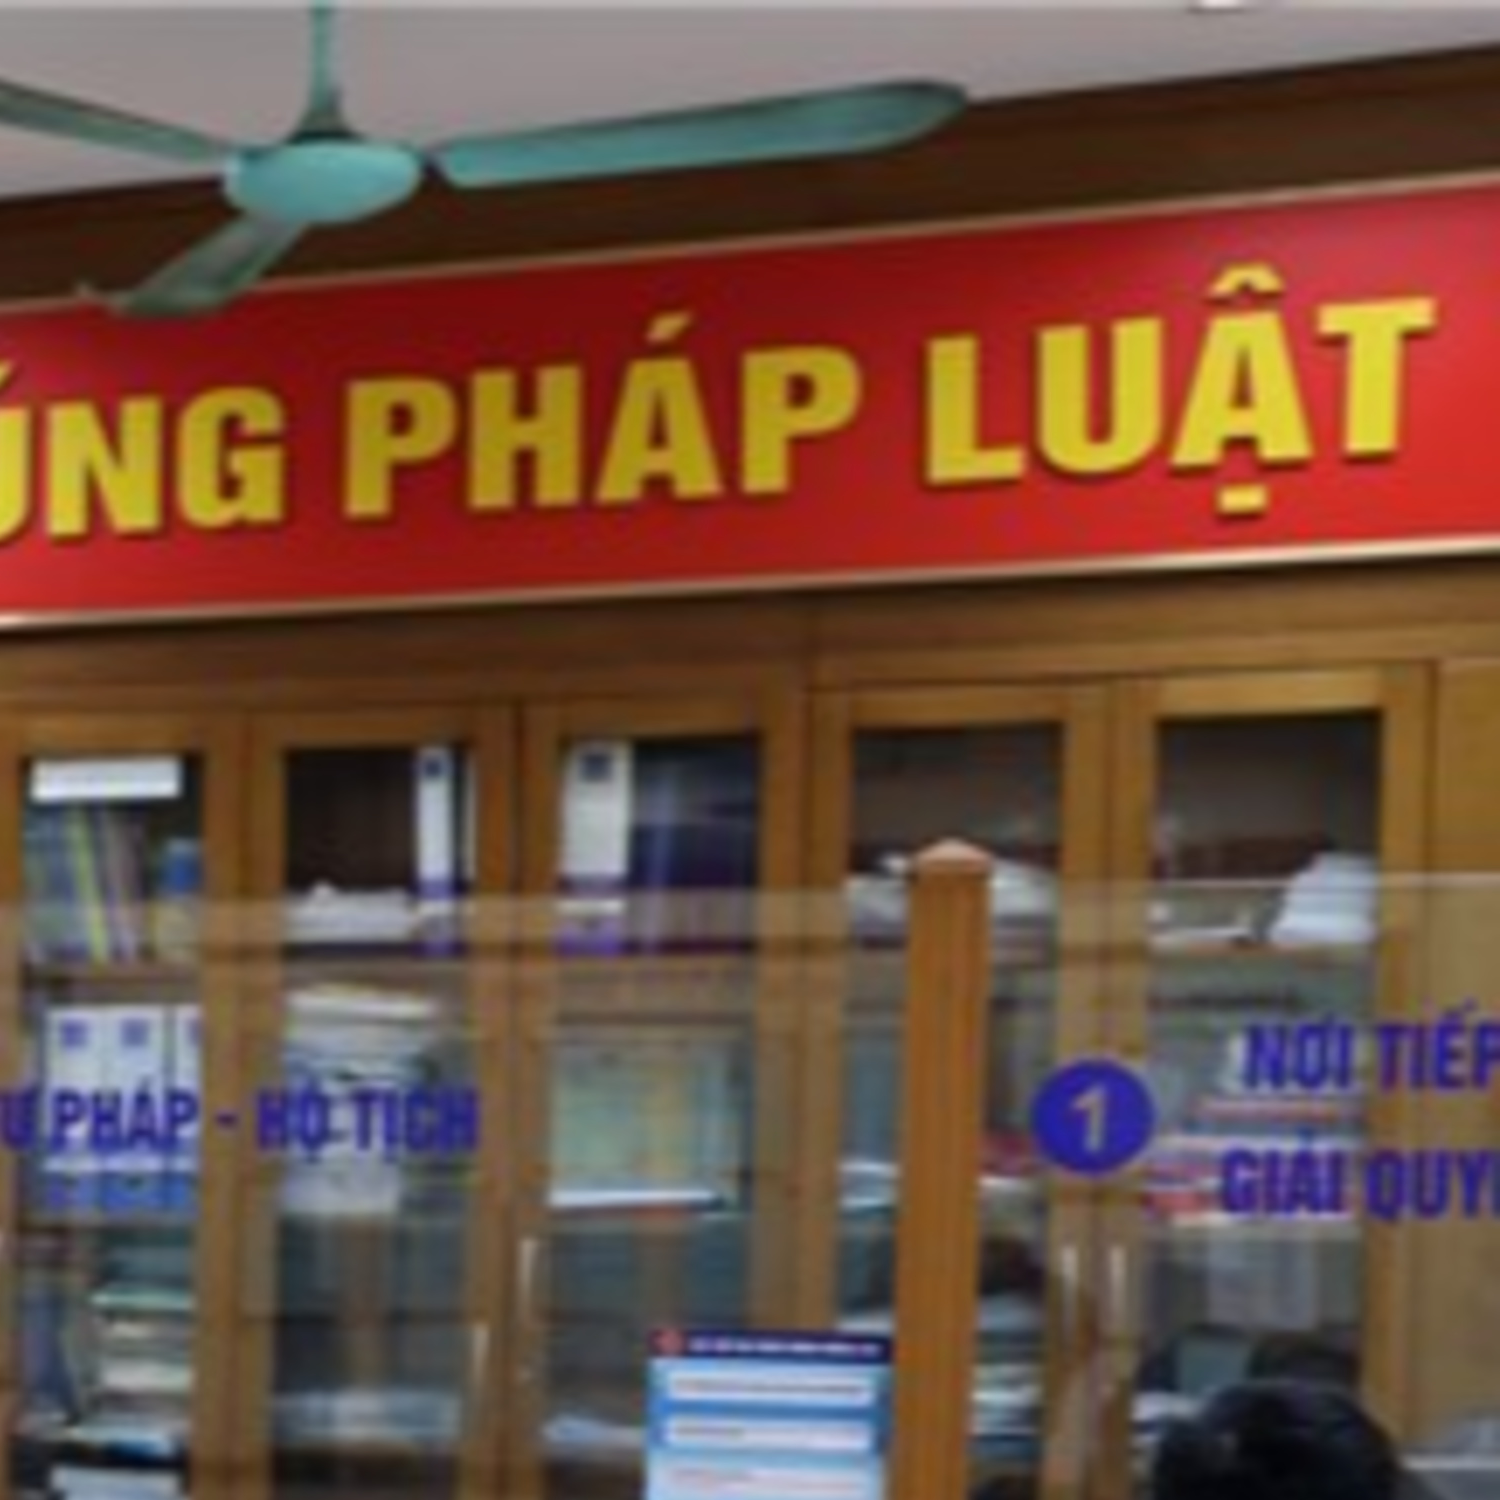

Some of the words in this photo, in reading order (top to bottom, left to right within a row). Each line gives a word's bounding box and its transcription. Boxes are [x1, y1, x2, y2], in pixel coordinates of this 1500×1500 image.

[343, 309, 862, 518] PHÁP
[923, 263, 1437, 514] LUẬT
[52, 1076, 199, 1152] PHÁP
[1068, 1081, 1110, 1153] 1
[1365, 1147, 1500, 1221] QUY
